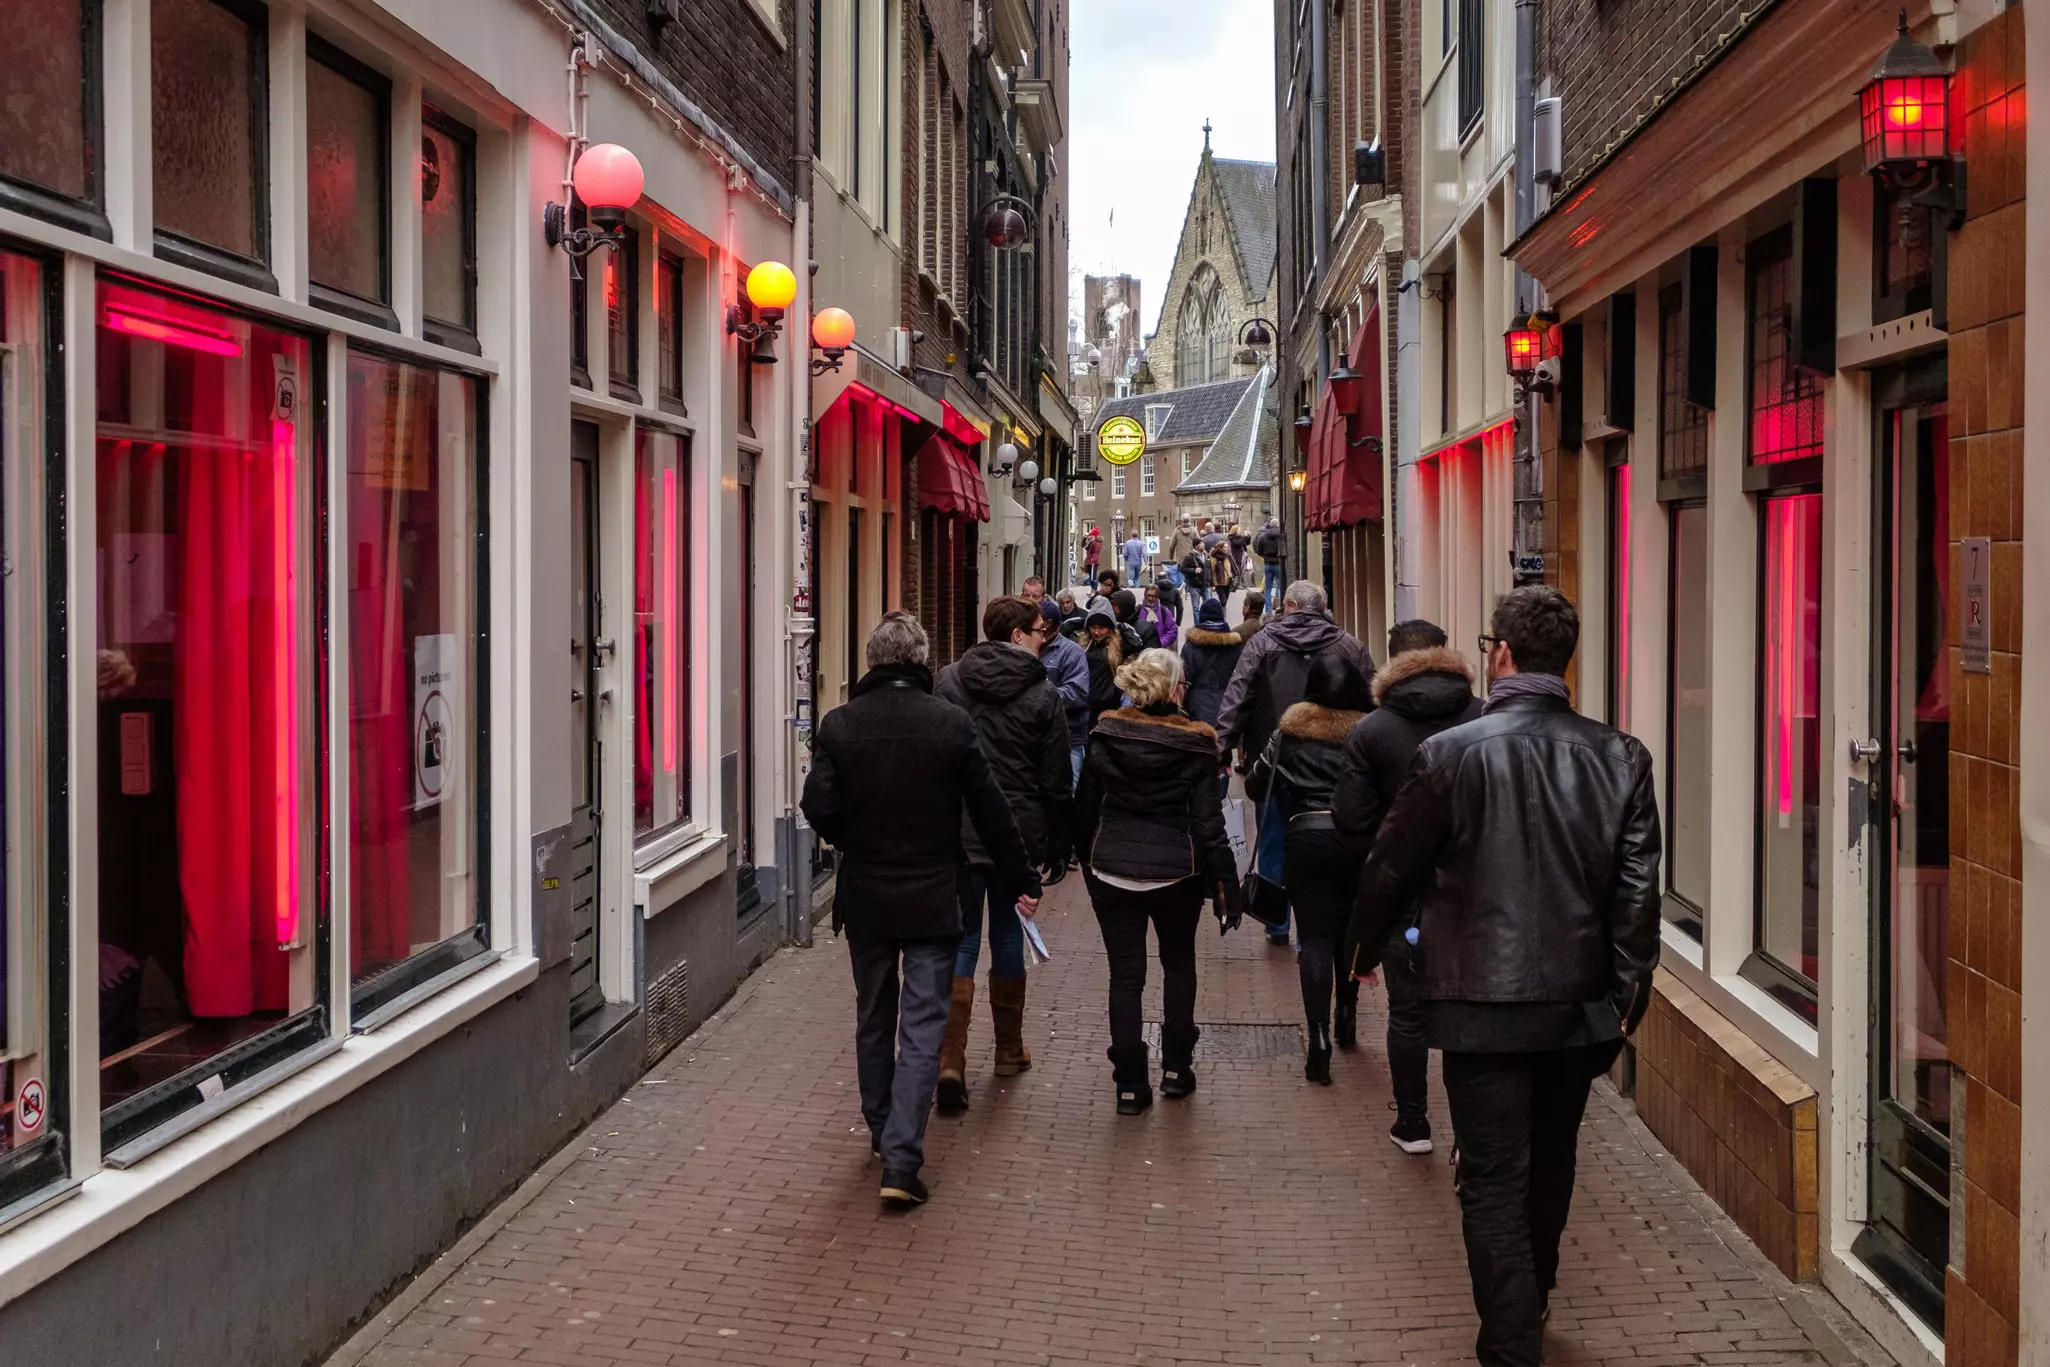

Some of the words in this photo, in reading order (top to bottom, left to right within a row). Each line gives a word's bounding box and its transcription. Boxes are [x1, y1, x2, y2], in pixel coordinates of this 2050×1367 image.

[1102, 436, 1141, 445] Heineken
[1970, 546, 1980, 580] 7
[420, 675, 428, 685] no
